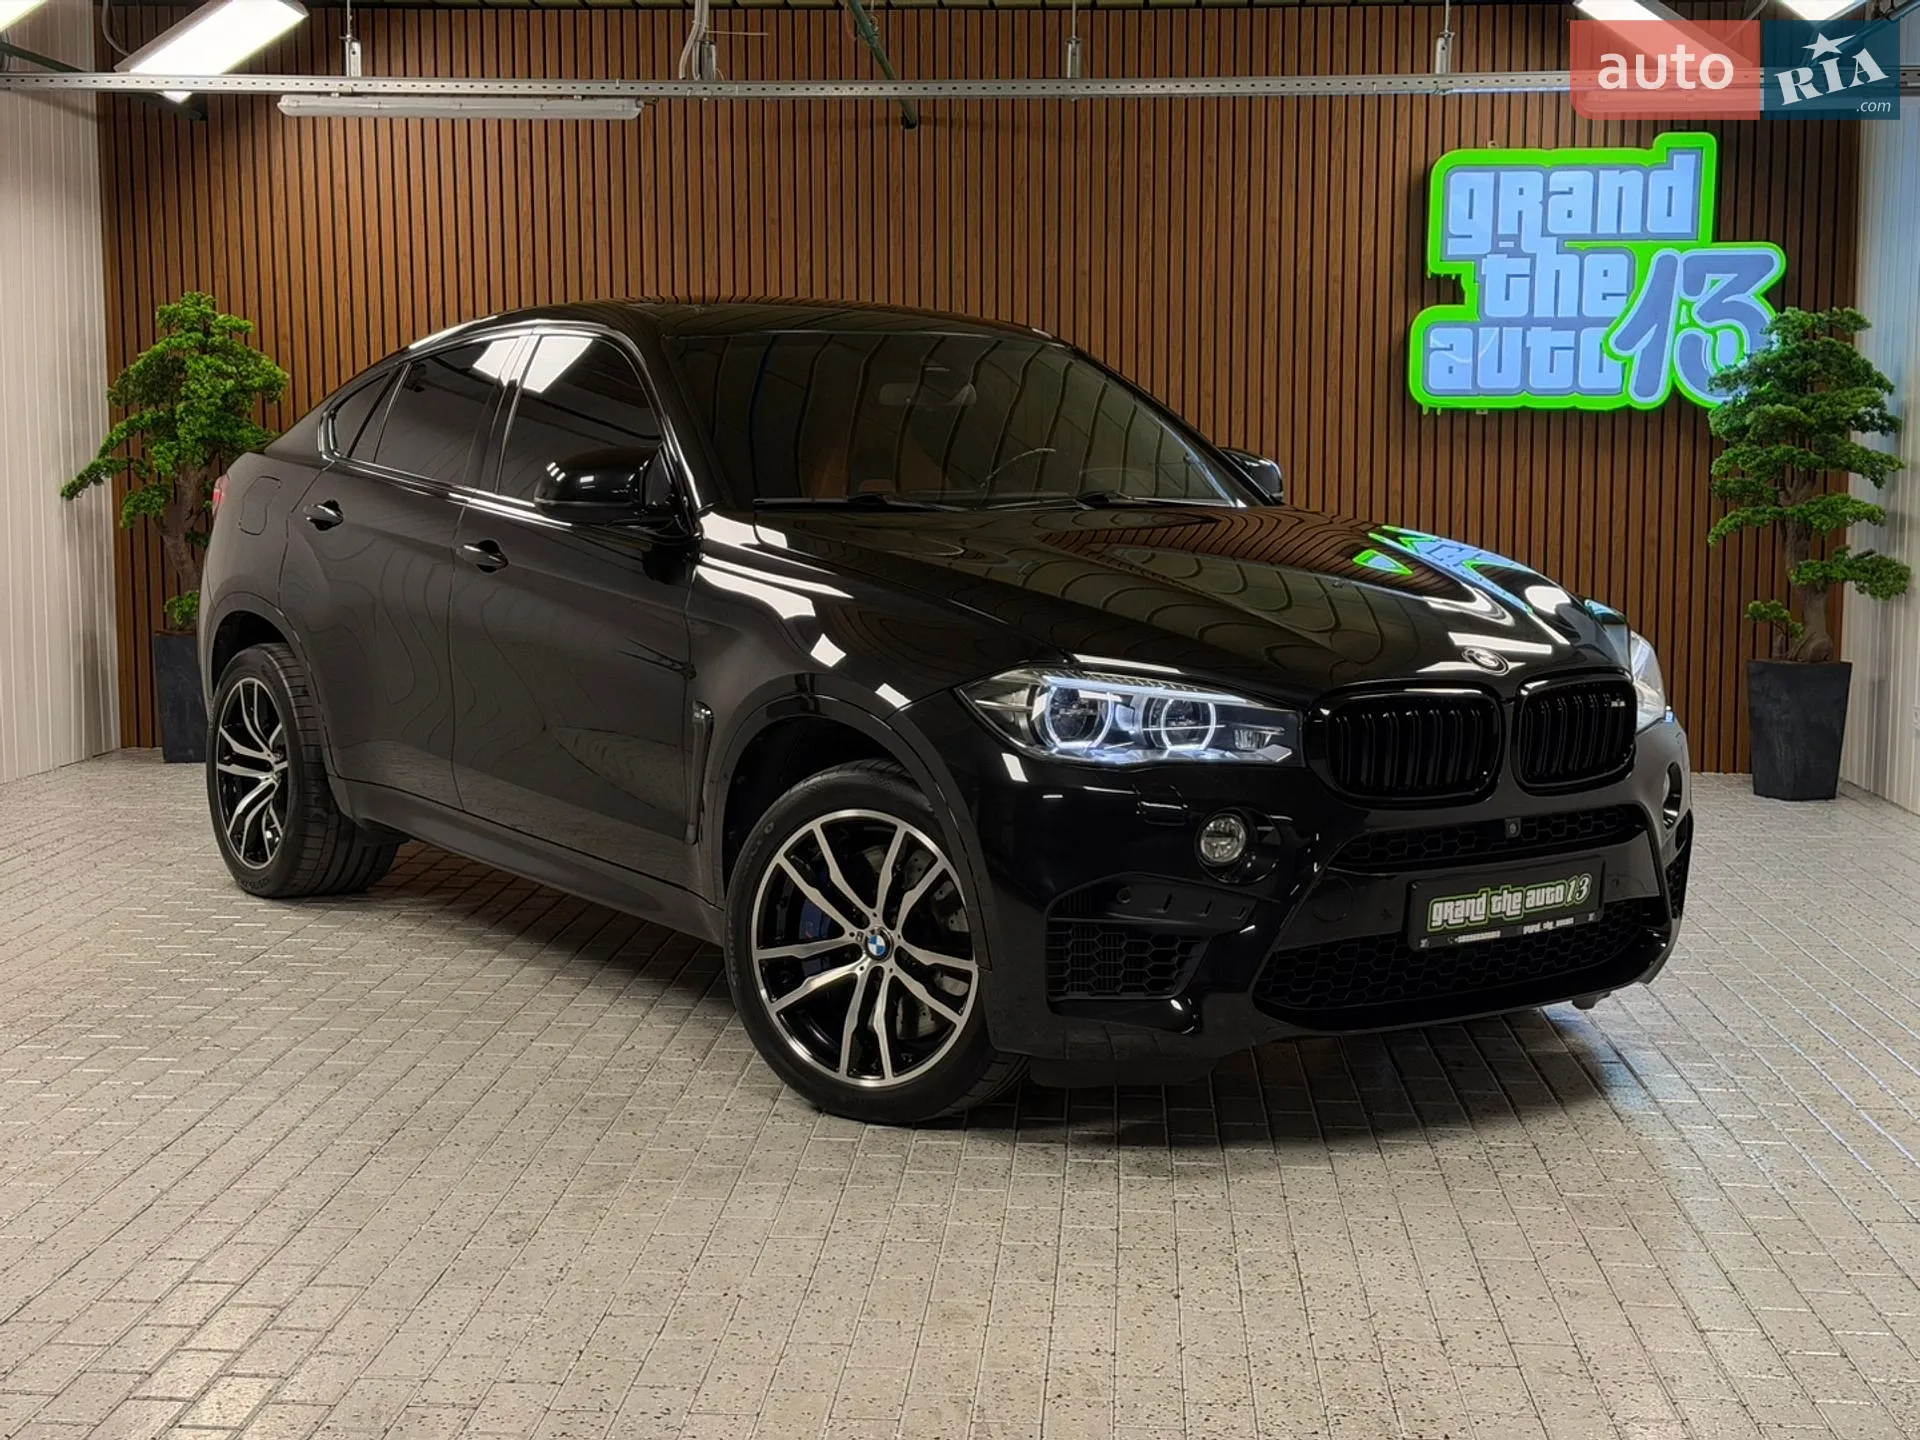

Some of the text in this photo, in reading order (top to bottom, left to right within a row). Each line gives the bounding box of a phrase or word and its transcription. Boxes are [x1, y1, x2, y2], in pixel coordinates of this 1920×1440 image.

[1482, 239, 1633, 319] the
[1428, 248, 1779, 403] auto 13
[1525, 883, 1564, 909] auto
[1566, 875, 1591, 903] 13
